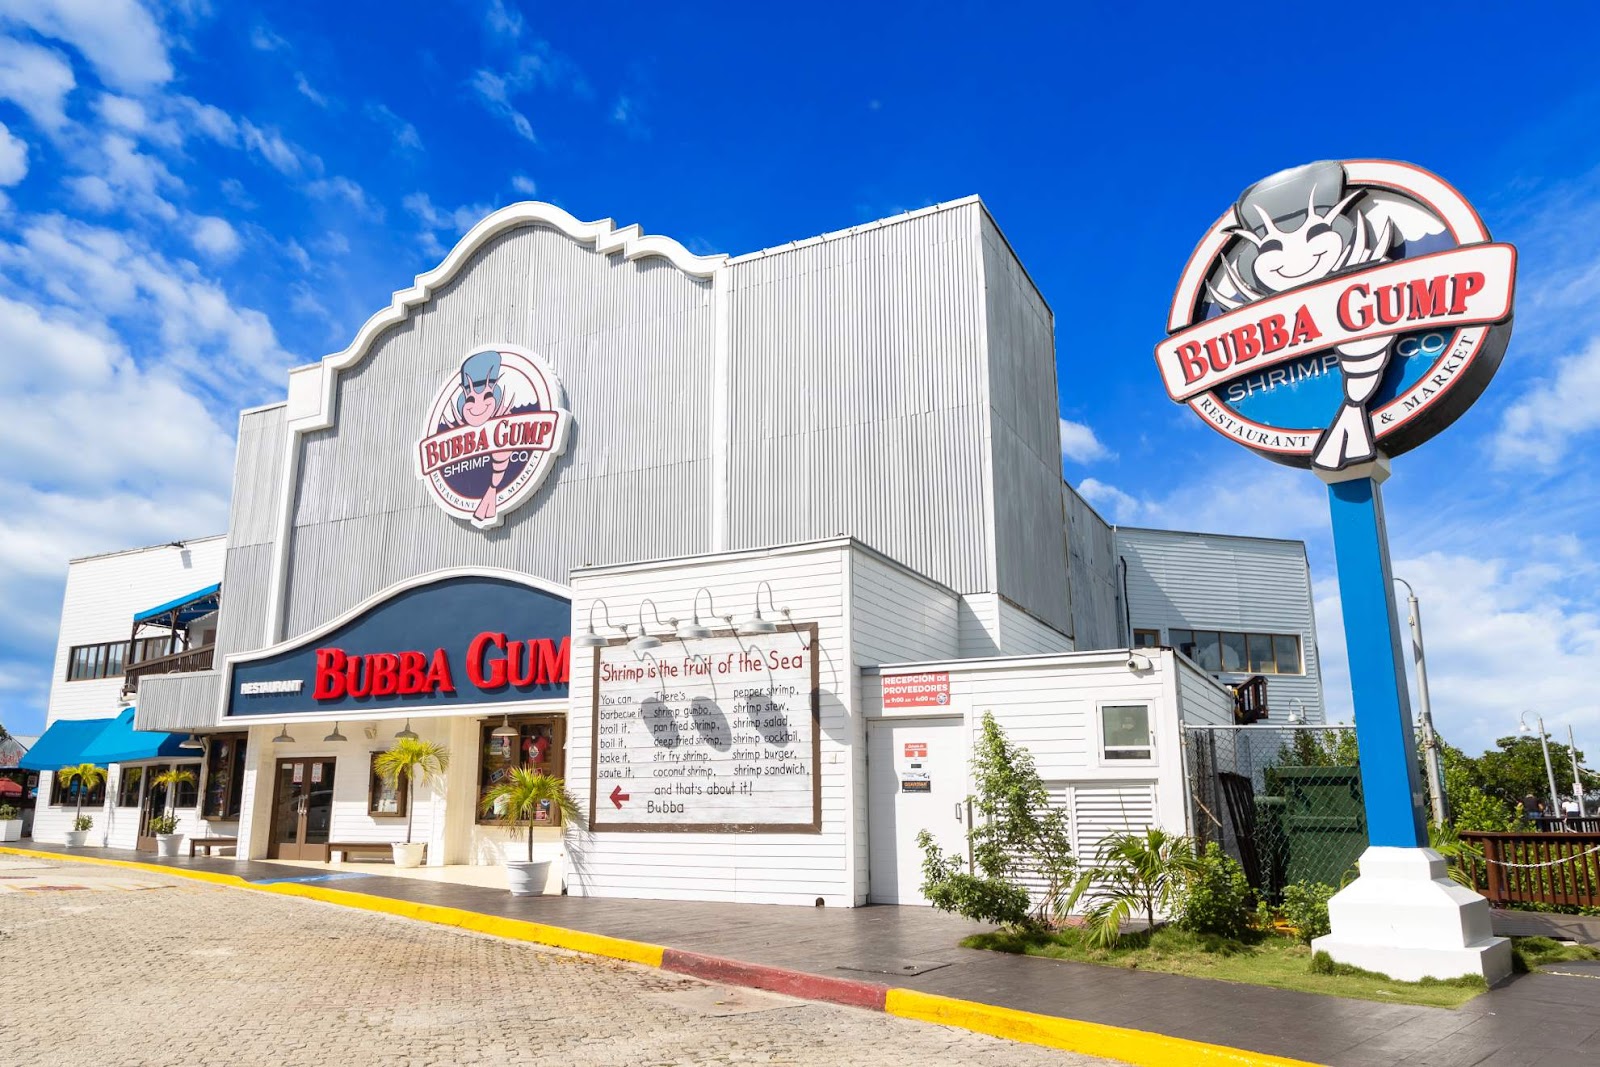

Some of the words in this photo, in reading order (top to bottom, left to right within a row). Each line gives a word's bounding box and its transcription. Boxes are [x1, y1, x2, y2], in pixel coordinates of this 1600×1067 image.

[1175, 304, 1323, 385] BUBBA
[1337, 272, 1486, 332] GUMP
[1228, 354, 1340, 402] SHRIMP
[1396, 333, 1445, 357] CO
[1380, 412, 1395, 425] &
[1402, 335, 1475, 412] MARKET
[1200, 398, 1310, 448] RESTAURANT
[425, 427, 490, 469] BUBBA
[494, 420, 552, 447] GUMP
[444, 455, 490, 478] SHRIMP
[510, 451, 529, 463] CO
[508, 454, 538, 496] MARKET
[433, 472, 477, 509] RESTAURANT
[312, 647, 455, 700] BUBBA
[466, 631, 571, 689] GUM
[647, 663, 656, 678] is
[659, 660, 678, 678] the
[684, 657, 712, 676] fruit
[718, 653, 734, 674] of
[739, 652, 762, 673] the
[885, 674, 935, 685] RECEPCIÓN
[240, 680, 304, 695] RESTAURANT
[733, 688, 764, 701] pepper
[884, 684, 948, 695] PROVEEDORES
[601, 695, 615, 705] You
[601, 710, 635, 720] barbecue
[654, 706, 680, 719] shrimp
[733, 703, 762, 716] shrimp
[601, 724, 618, 735] broil
[654, 725, 668, 734] pan
[670, 721, 688, 732] fried
[733, 717, 761, 731] shrimp
[601, 738, 615, 748] boil
[654, 737, 674, 749] deep
[676, 735, 693, 747] fried
[733, 733, 760, 747] shrimp
[601, 753, 620, 763] bake
[654, 751, 665, 761] stir
[669, 751, 680, 764] fry
[732, 749, 760, 763] shrimp
[599, 768, 621, 778] saute
[653, 765, 685, 777] coconut
[734, 764, 762, 779] shrimp
[654, 783, 671, 795] and
[676, 782, 702, 795] that's
[706, 782, 735, 795] about
[740, 781, 753, 796] it!
[647, 800, 684, 813] Bubba
